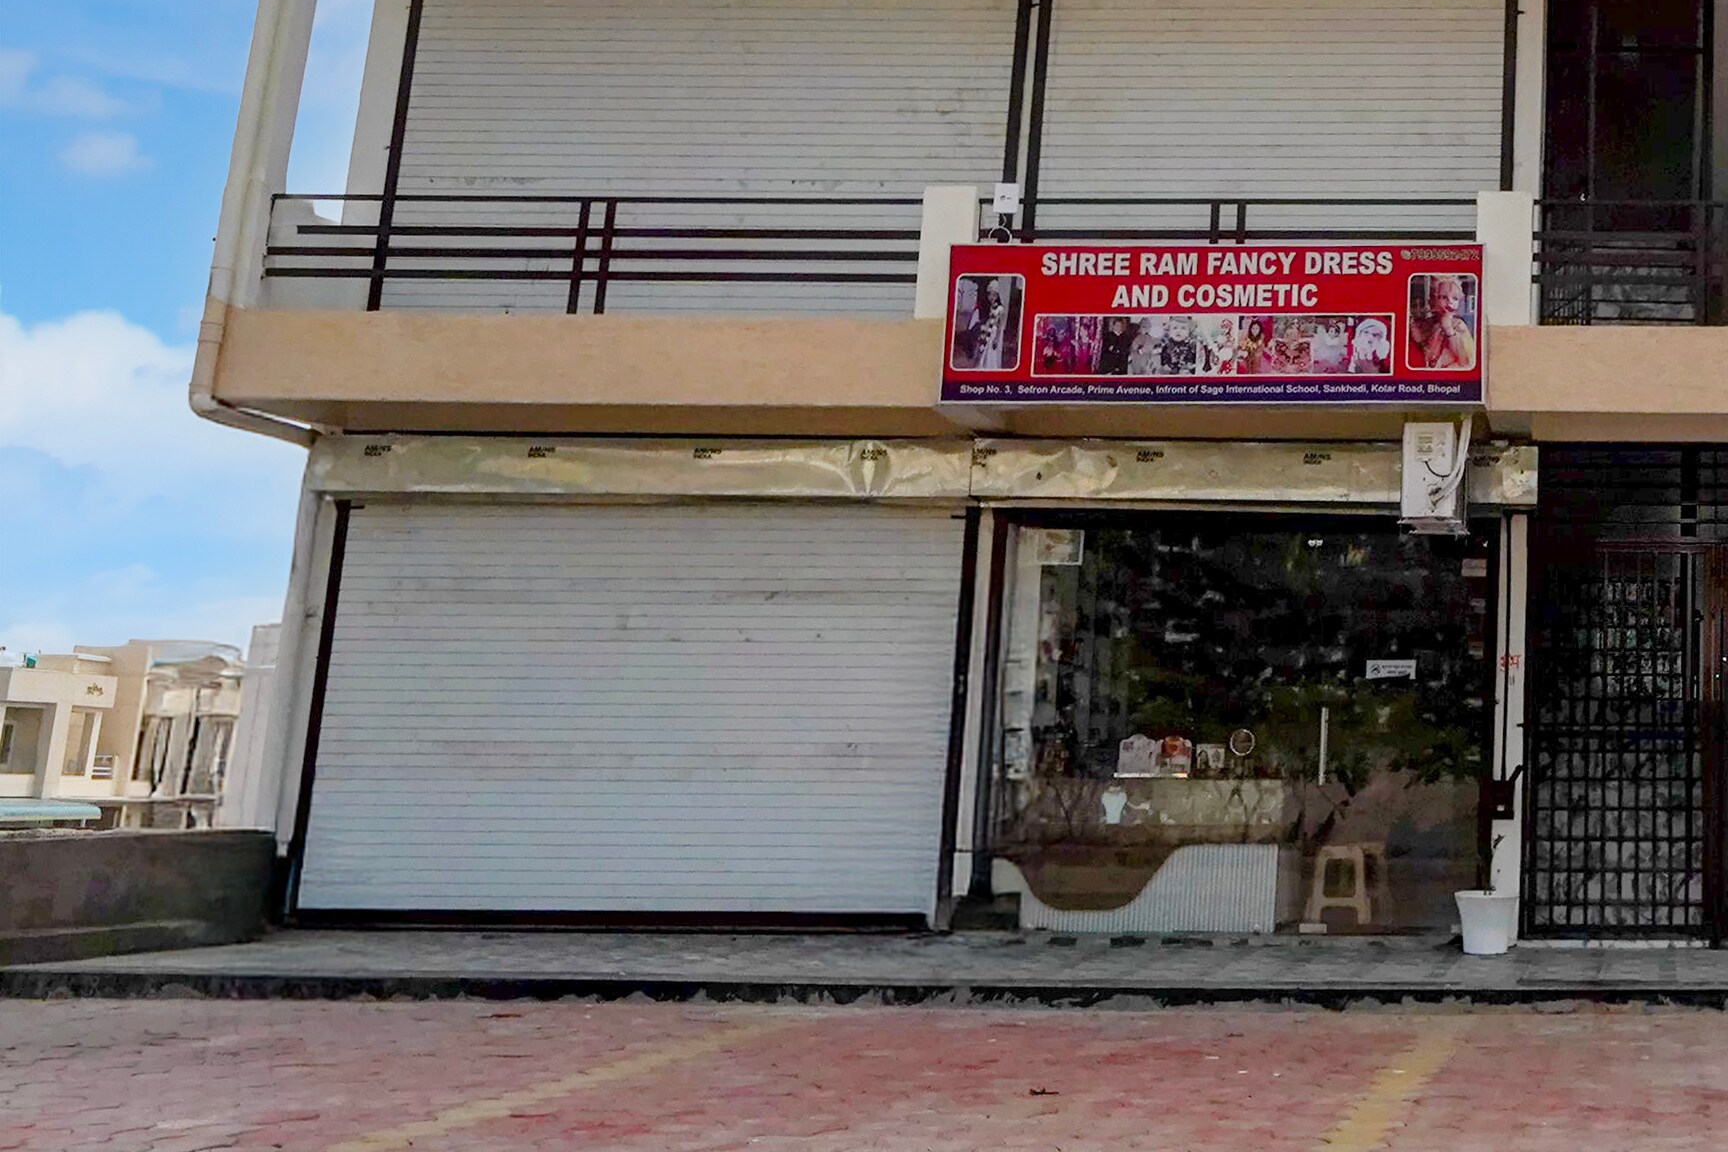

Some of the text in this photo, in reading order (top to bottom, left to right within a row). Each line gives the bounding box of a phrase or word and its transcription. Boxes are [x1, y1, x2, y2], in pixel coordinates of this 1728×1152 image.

[1041, 251, 1394, 276] SHREE RAM FANCY DRESS
[1111, 283, 1319, 308] AND COSMETIC
[960, 384, 985, 396] Shop
[1050, 384, 1085, 396] Arcade,
[1087, 384, 1115, 396] Prime
[1116, 384, 1154, 396] Avenue,
[1156, 384, 1187, 396] Infront
[1189, 384, 1199, 396] of
[1201, 384, 1224, 396] Sage
[1226, 384, 1284, 396] International
[1286, 384, 1321, 396] School,
[1371, 384, 1396, 396] Kolar
[1398, 384, 1425, 396] Road,
[1427, 384, 1461, 396] Bhopal
